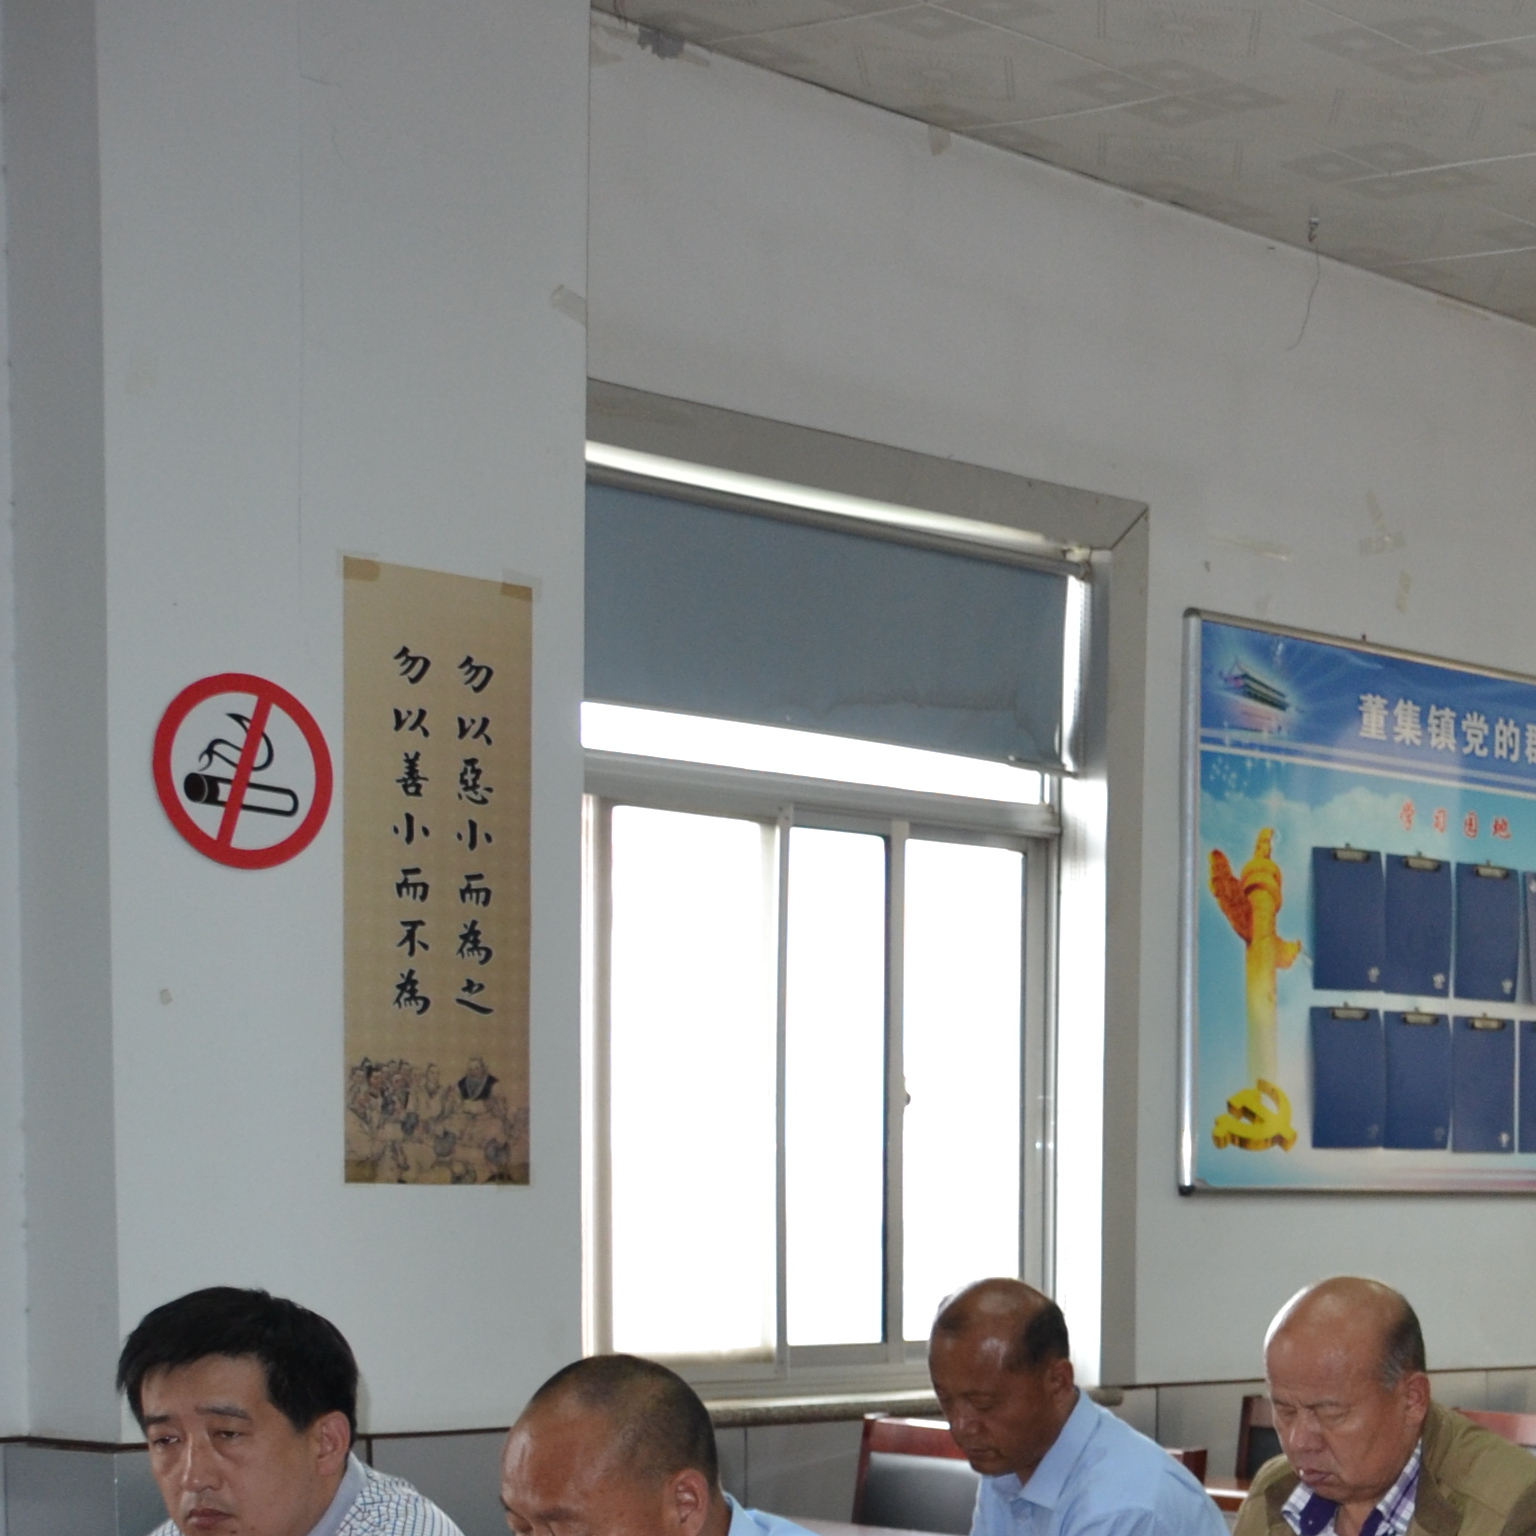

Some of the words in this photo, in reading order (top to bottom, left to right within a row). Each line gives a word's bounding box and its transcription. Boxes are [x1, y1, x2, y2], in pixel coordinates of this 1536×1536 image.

[393, 645, 431, 1017] 勿以善小而不為
[456, 654, 494, 1016] 勿以惡小而為之
[1400, 799, 1511, 838] 学习园地
